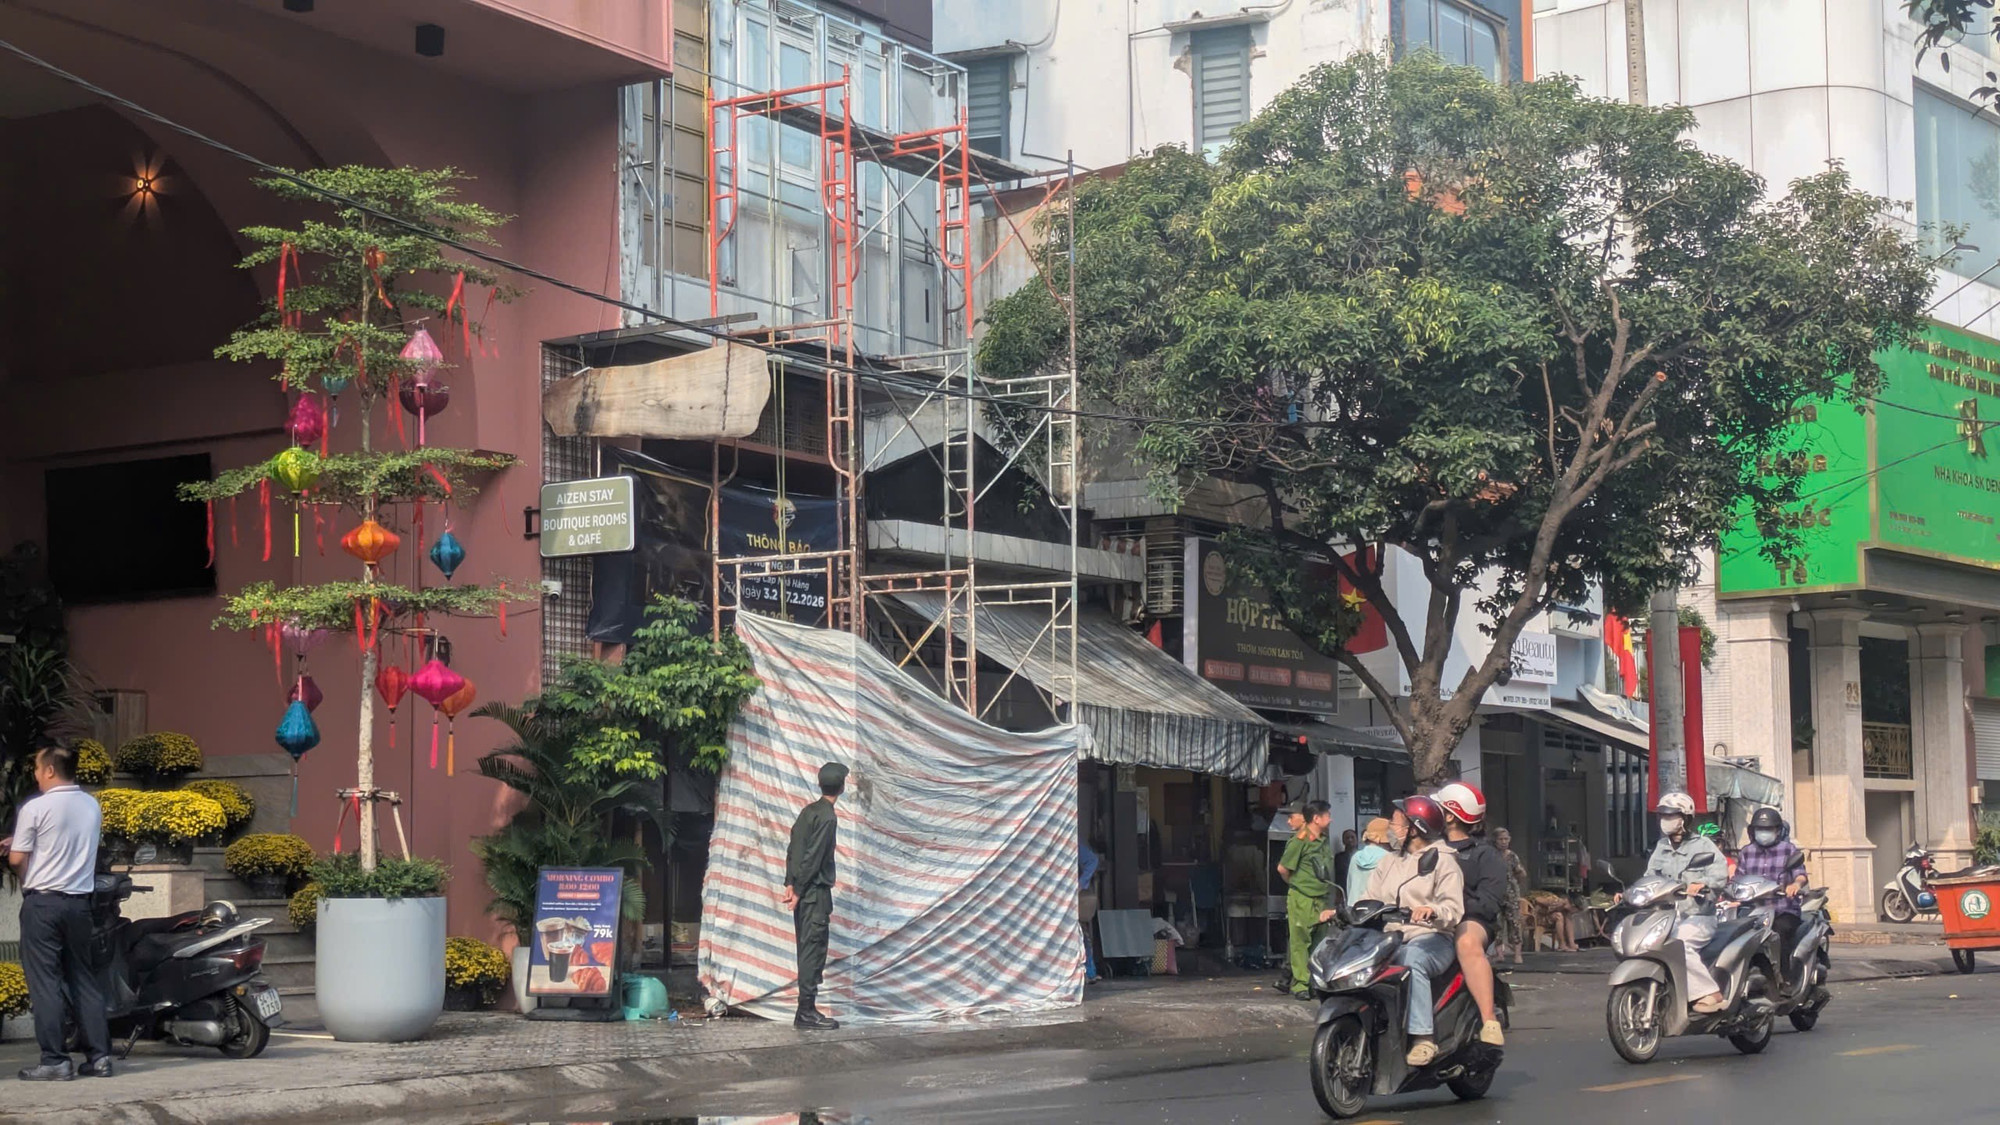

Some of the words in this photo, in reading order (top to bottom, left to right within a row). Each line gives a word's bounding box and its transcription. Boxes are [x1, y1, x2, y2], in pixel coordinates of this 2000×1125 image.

[1934, 465, 1951, 483] NHA
[1952, 469, 1974, 489] KHOA
[1974, 475, 1986, 491] SK
[556, 491, 588, 505] AIZEN
[589, 488, 614, 502] STAY
[543, 516, 591, 532] BOUTIQUE
[592, 512, 627, 527] ROOMS
[568, 534, 576, 547] &
[576, 529, 602, 546] CAFÉ
[763, 587, 778, 600] 3.2
[785, 591, 825, 608] 7.2.2026
[546, 873, 584, 882] MORNING
[584, 874, 615, 883] COMBO
[593, 928, 613, 938] 79k
